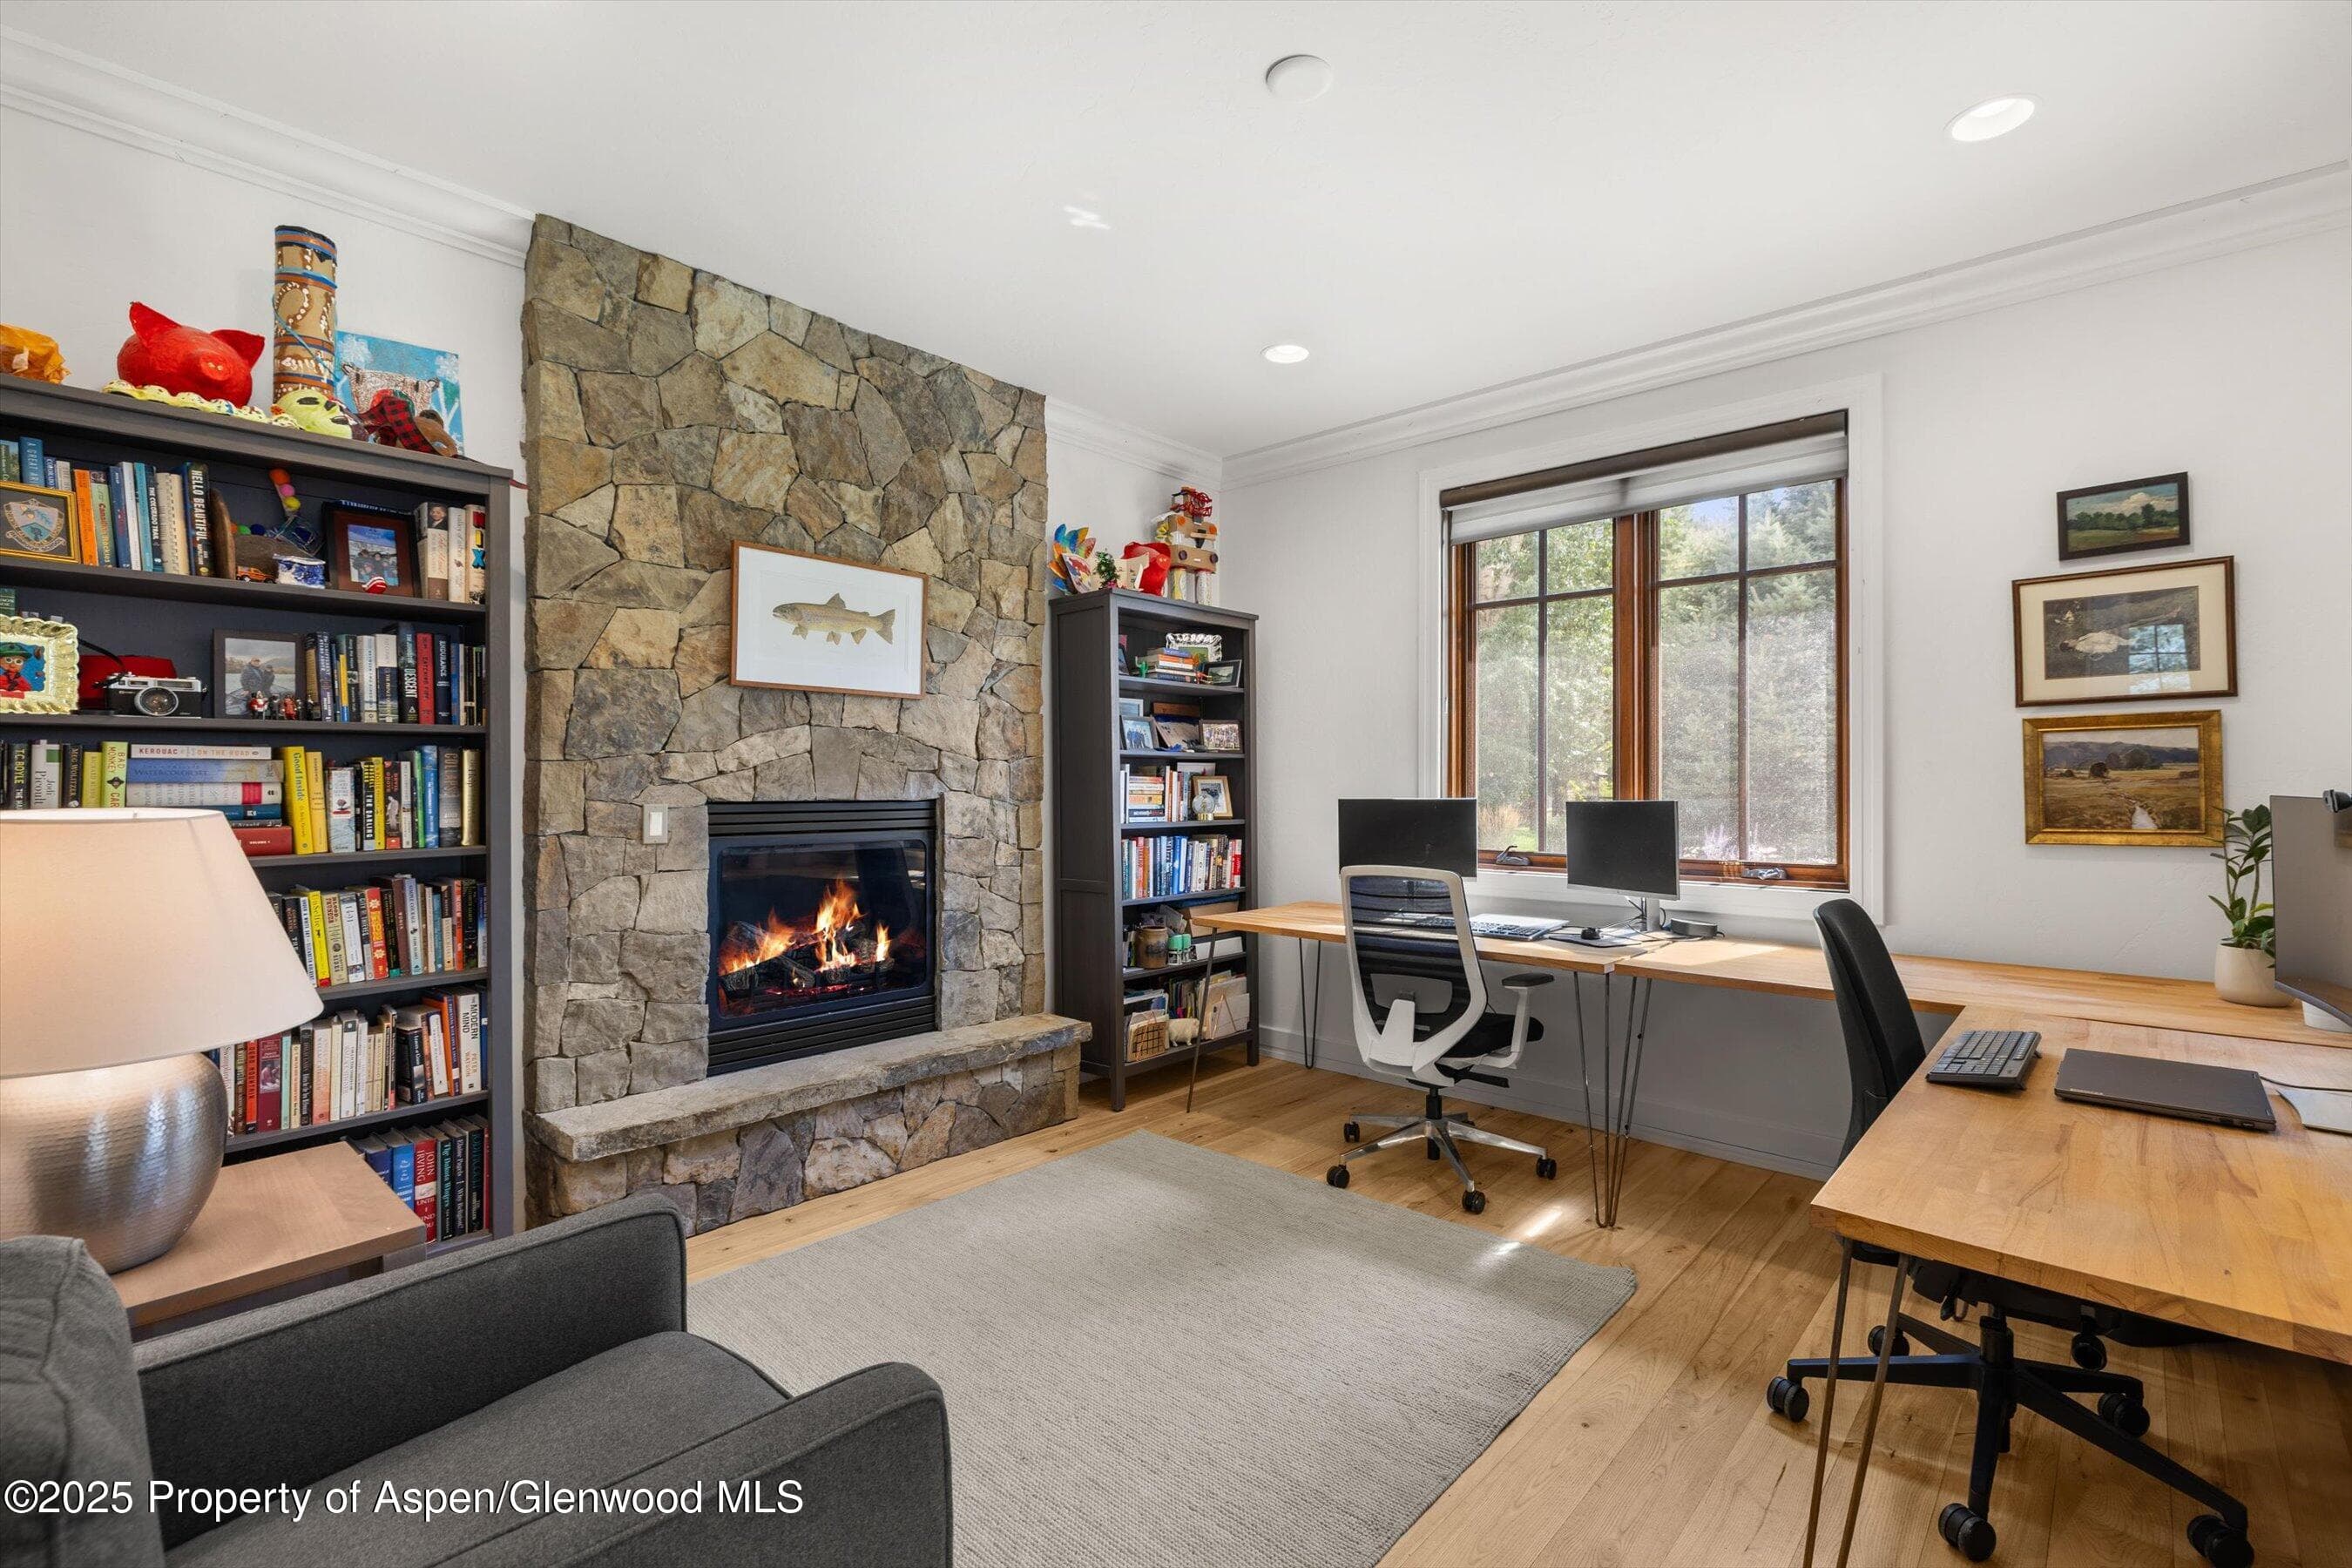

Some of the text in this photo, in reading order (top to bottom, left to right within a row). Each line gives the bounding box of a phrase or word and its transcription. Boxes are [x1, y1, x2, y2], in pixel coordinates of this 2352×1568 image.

[27, 449, 37, 470] GREAT
[30, 472, 39, 484] ARI
[191, 470, 207, 541] HELLO BEAUTIFUL
[102, 536, 111, 563] Rockies
[404, 668, 417, 699] DESCENT
[14, 761, 25, 784] BOYLE
[293, 753, 301, 774] Good
[15, 788, 24, 799] THE
[34, 770, 46, 805] Picoult
[46, 779, 55, 796] Jodi
[296, 776, 305, 801] Inside
[110, 792, 119, 808] CAR
[443, 1143, 451, 1156] The
[416, 1150, 425, 1182] IRVING
[426, 1151, 436, 1176] JOHN
